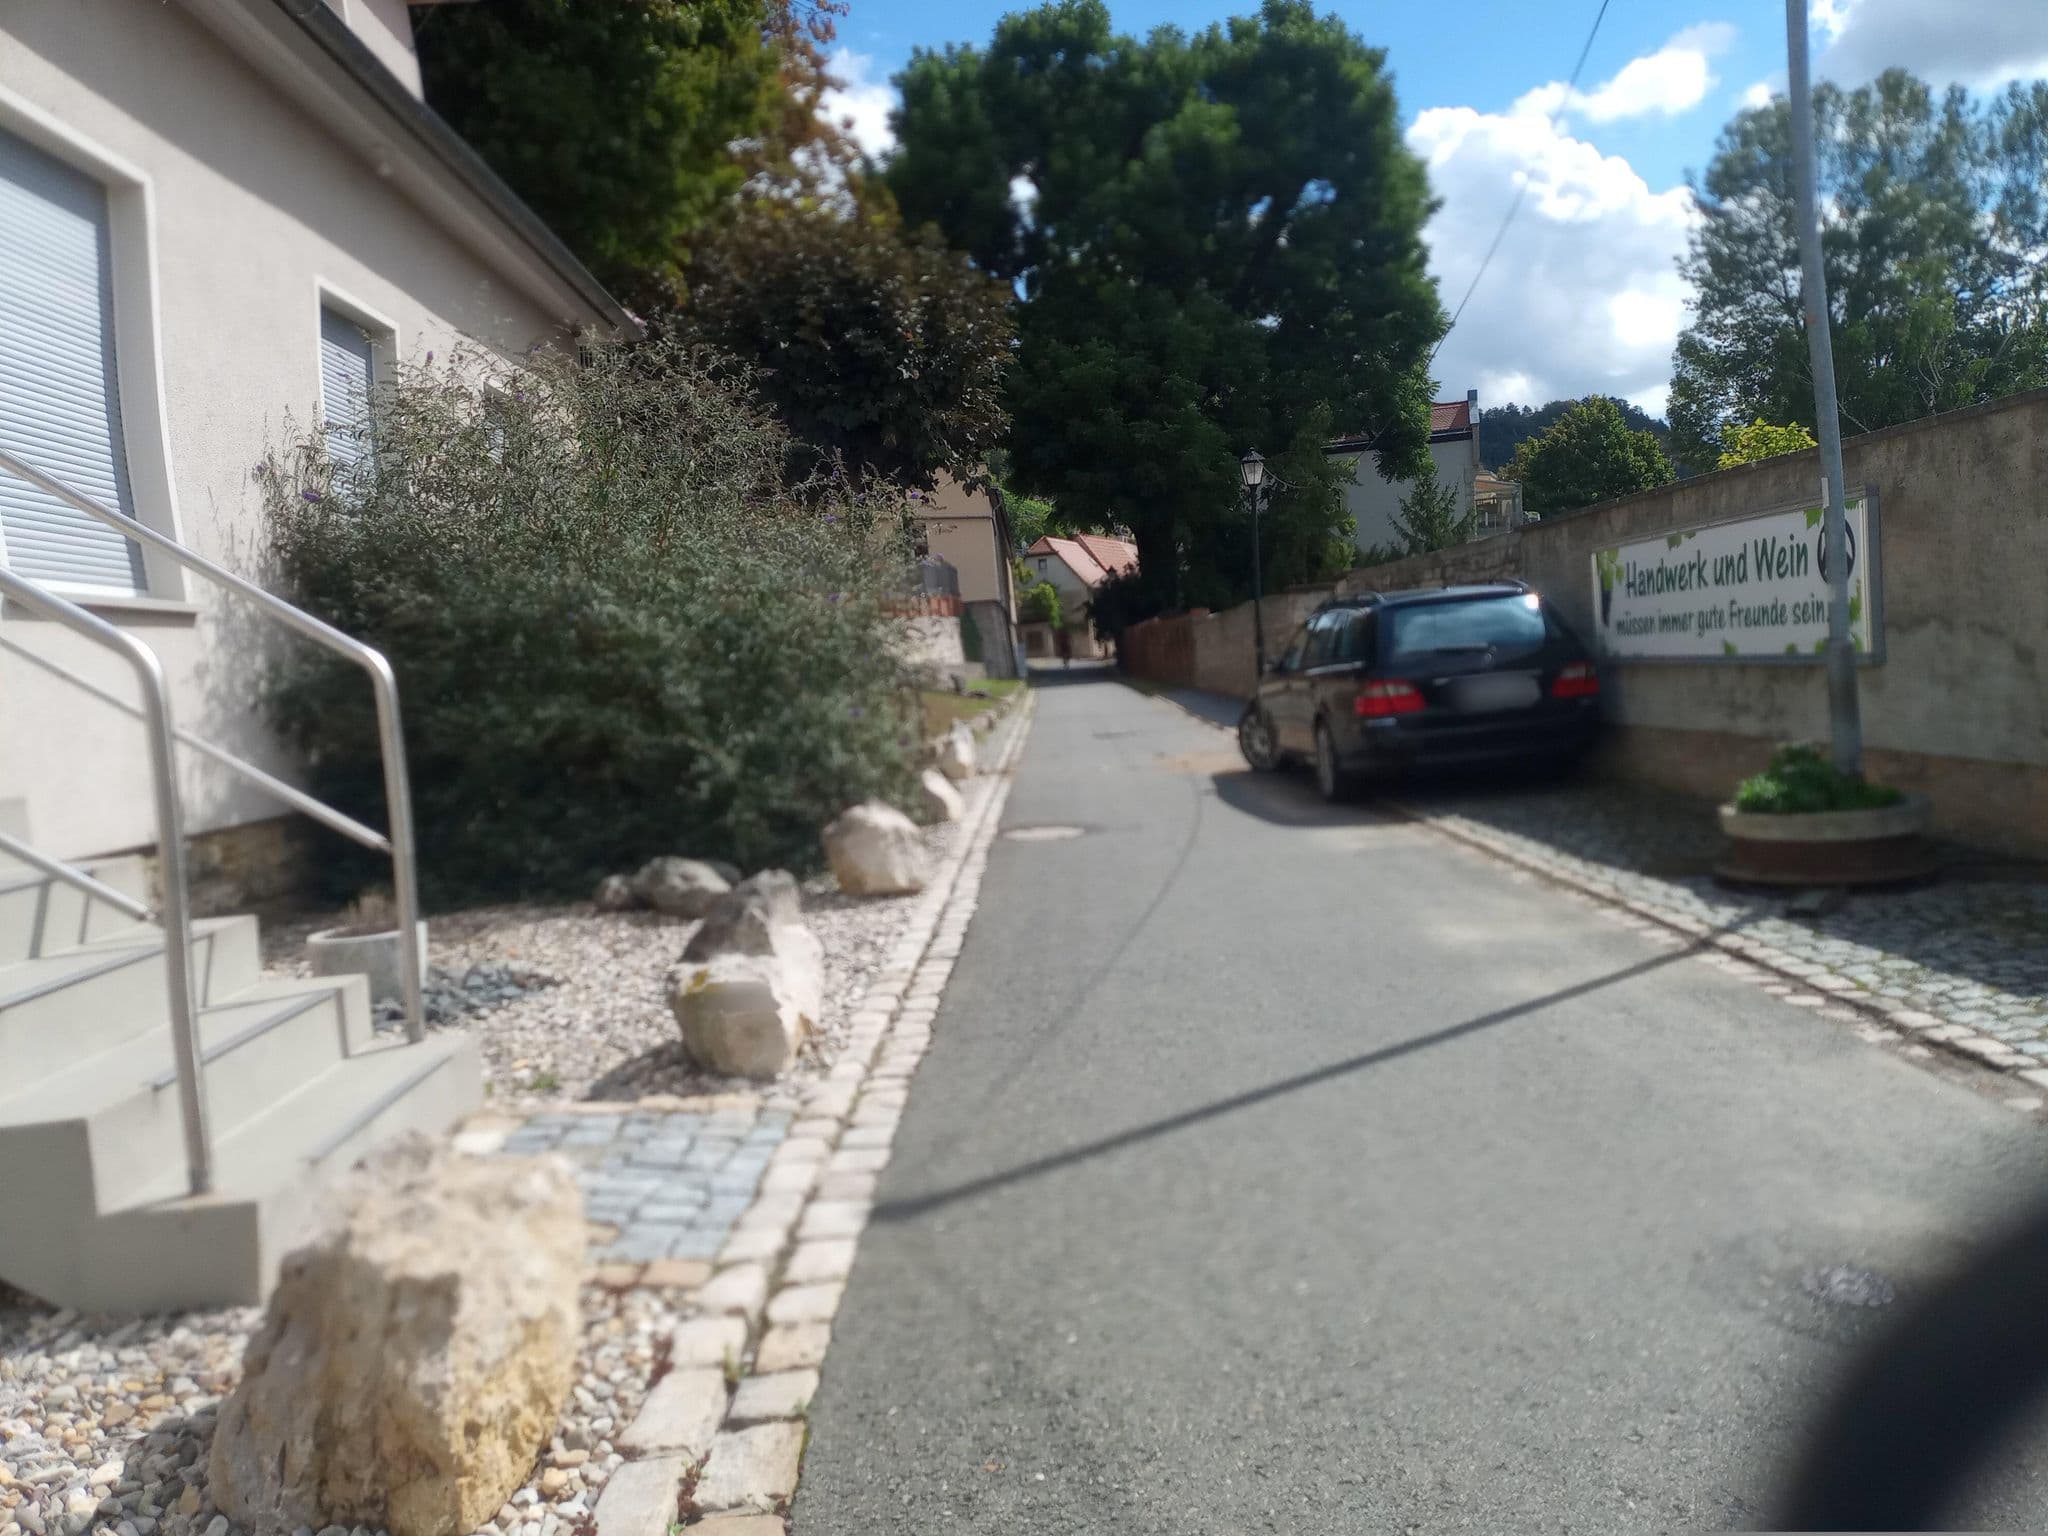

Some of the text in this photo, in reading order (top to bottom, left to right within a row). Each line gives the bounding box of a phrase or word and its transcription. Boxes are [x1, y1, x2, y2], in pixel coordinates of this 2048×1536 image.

[1625, 533, 1808, 599] Handwerk und Wein
[1616, 609, 1656, 636] müssen
[1658, 607, 1694, 633] immer
[1697, 603, 1727, 640] gute
[1729, 597, 1788, 629] Freunde
